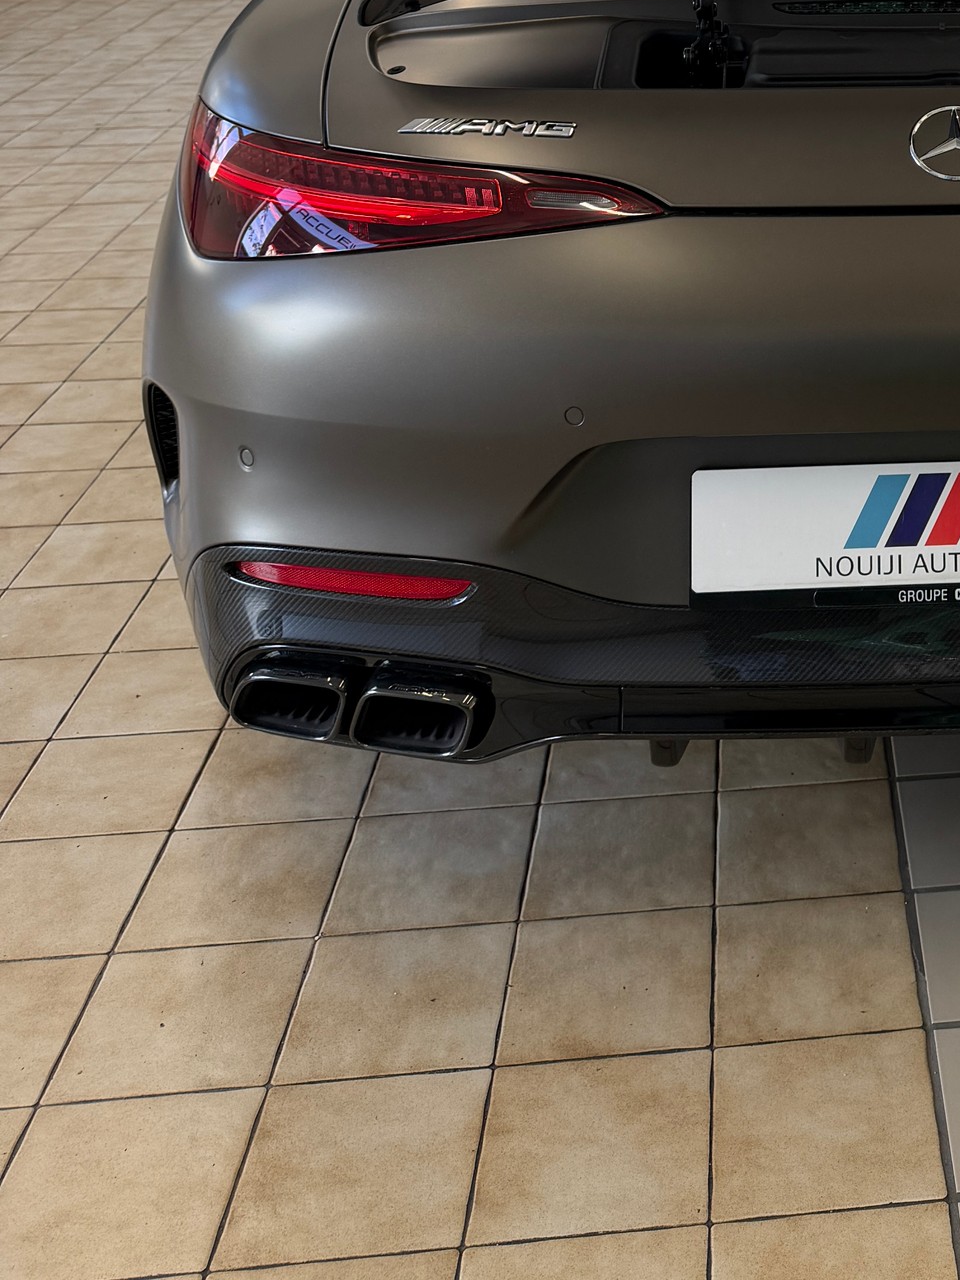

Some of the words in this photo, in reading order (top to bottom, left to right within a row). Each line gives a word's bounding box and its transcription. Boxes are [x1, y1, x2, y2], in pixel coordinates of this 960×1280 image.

[296, 208, 356, 250] ACCUE
[815, 554, 902, 578] NOUIJI
[898, 588, 948, 603] GROUPE
